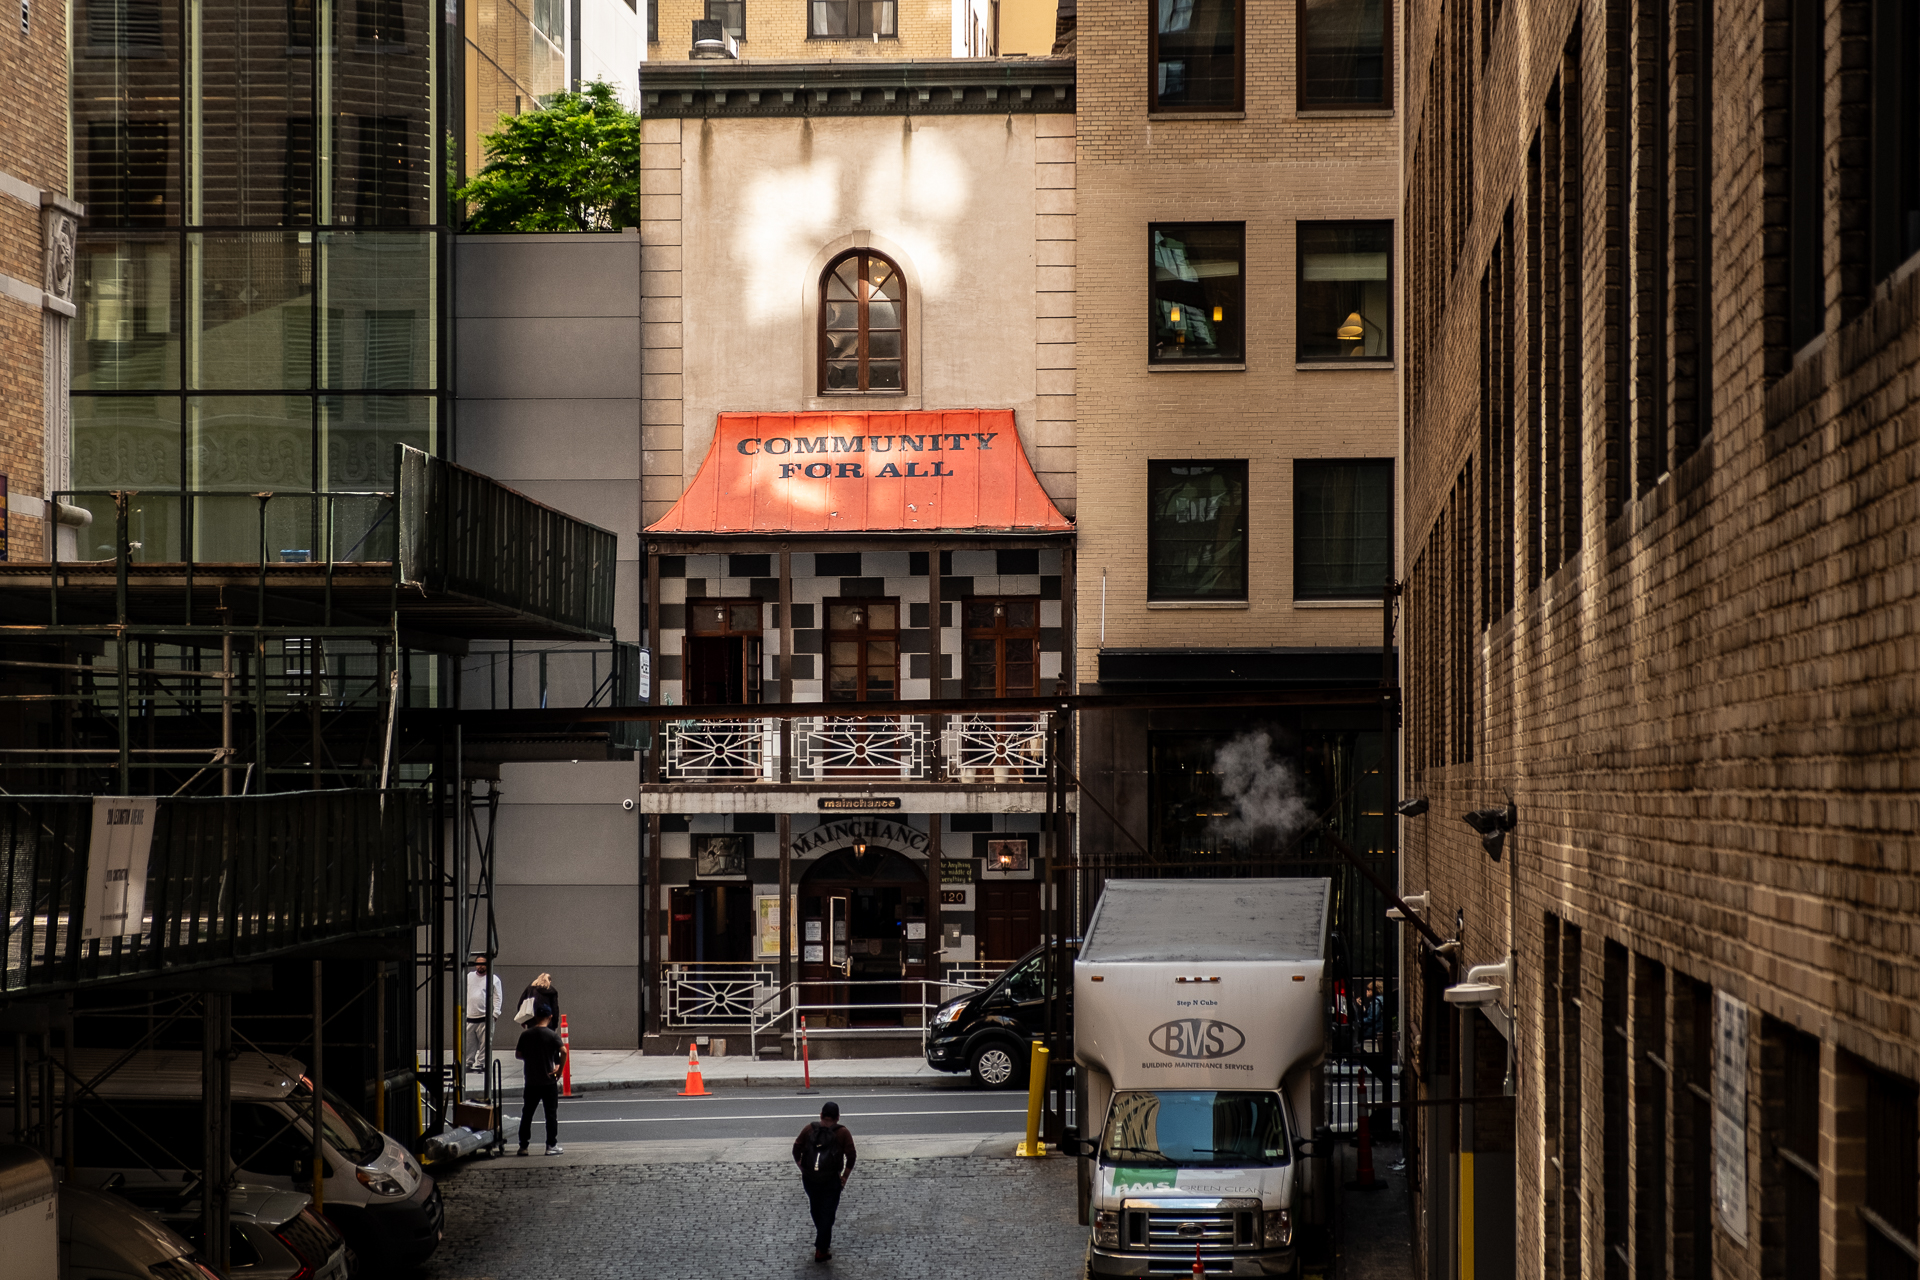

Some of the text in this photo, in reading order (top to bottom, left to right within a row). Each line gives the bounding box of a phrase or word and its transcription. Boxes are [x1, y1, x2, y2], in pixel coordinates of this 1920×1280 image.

[736, 432, 999, 456] COMMUNITY
[778, 461, 954, 480] FOR ALL
[824, 799, 896, 808] mainchance
[941, 876, 966, 884] verything
[942, 892, 964, 902] 120
[1165, 1020, 1225, 1057] BMS
[1174, 1062, 1223, 1070] MAINTENANCE
[1224, 1063, 1254, 1071] SERVICES
[1115, 1181, 1264, 1196] BMS GREEN CLEAN
